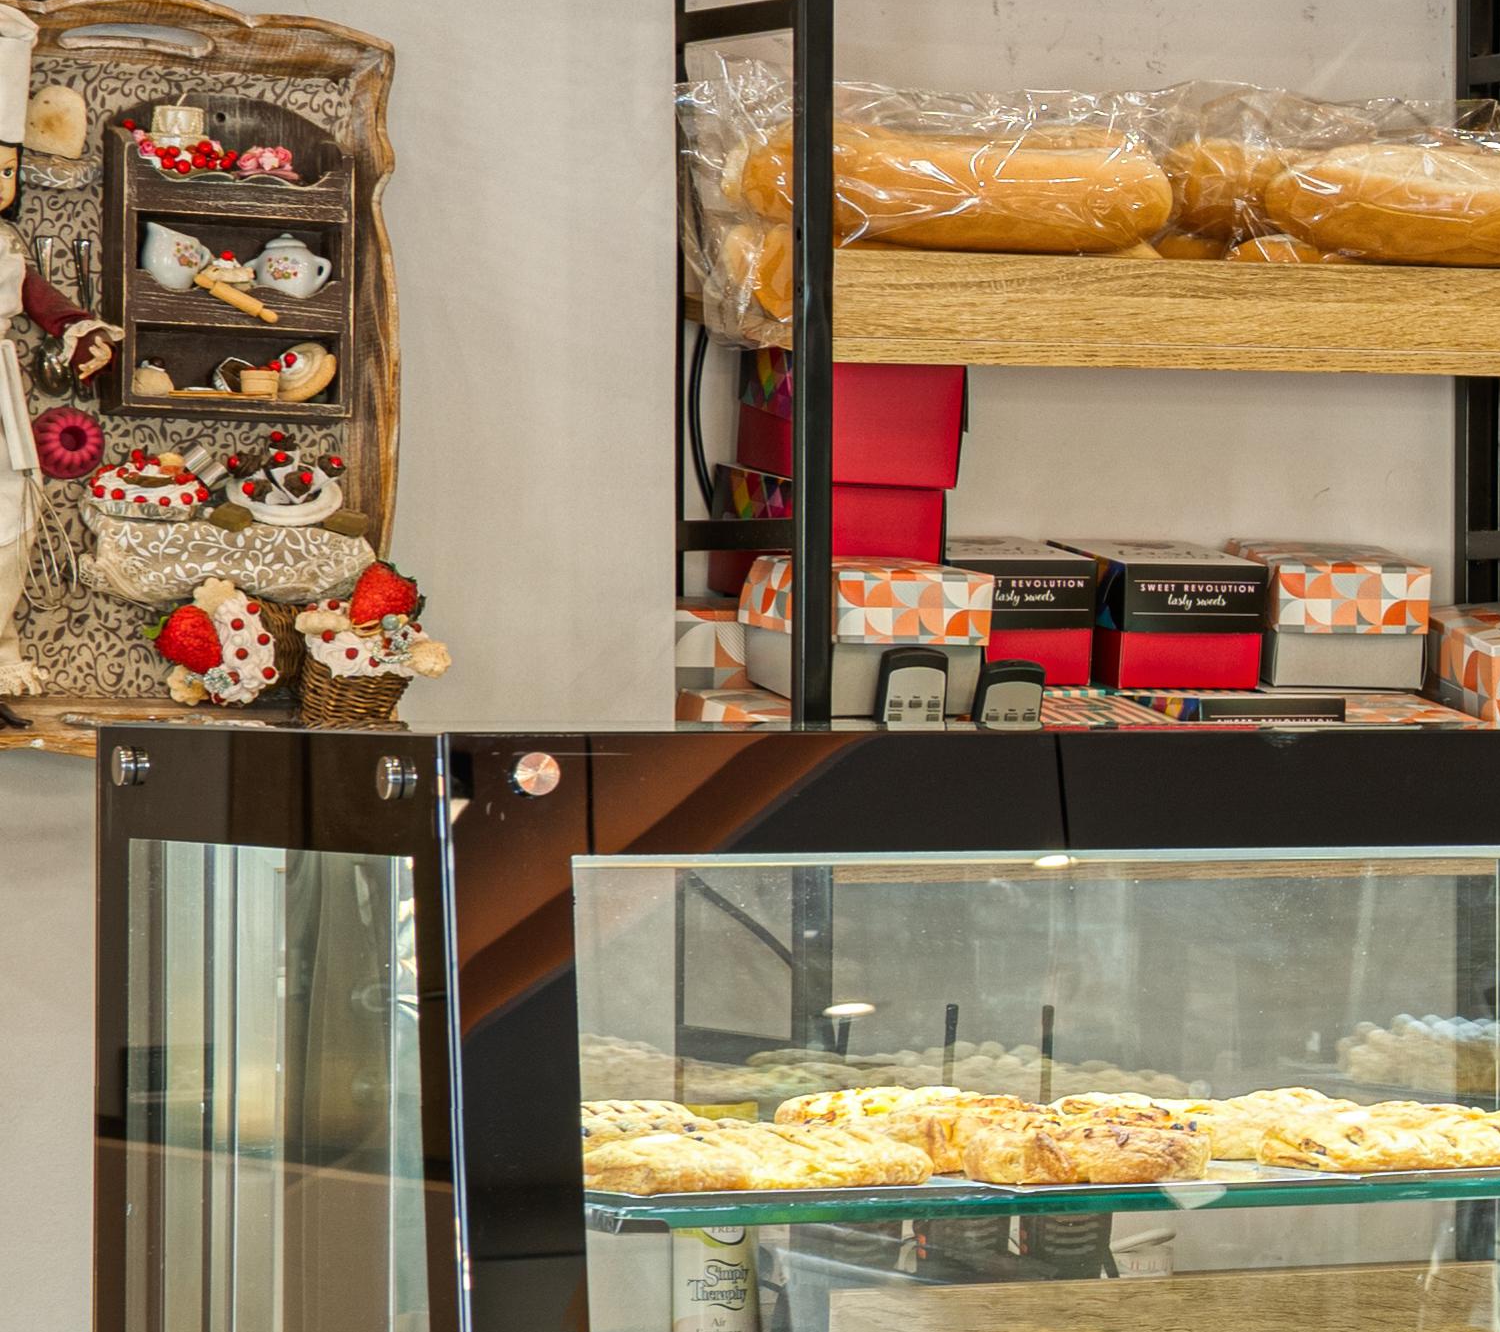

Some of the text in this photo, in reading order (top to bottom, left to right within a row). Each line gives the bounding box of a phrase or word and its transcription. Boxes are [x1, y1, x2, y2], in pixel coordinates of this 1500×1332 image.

[1011, 579, 1085, 589] REVOLUTION
[1140, 583, 1256, 594] SWEET REVOLUTION
[995, 590, 1056, 606] tasty sweets
[1168, 594, 1227, 611] tasty sweets
